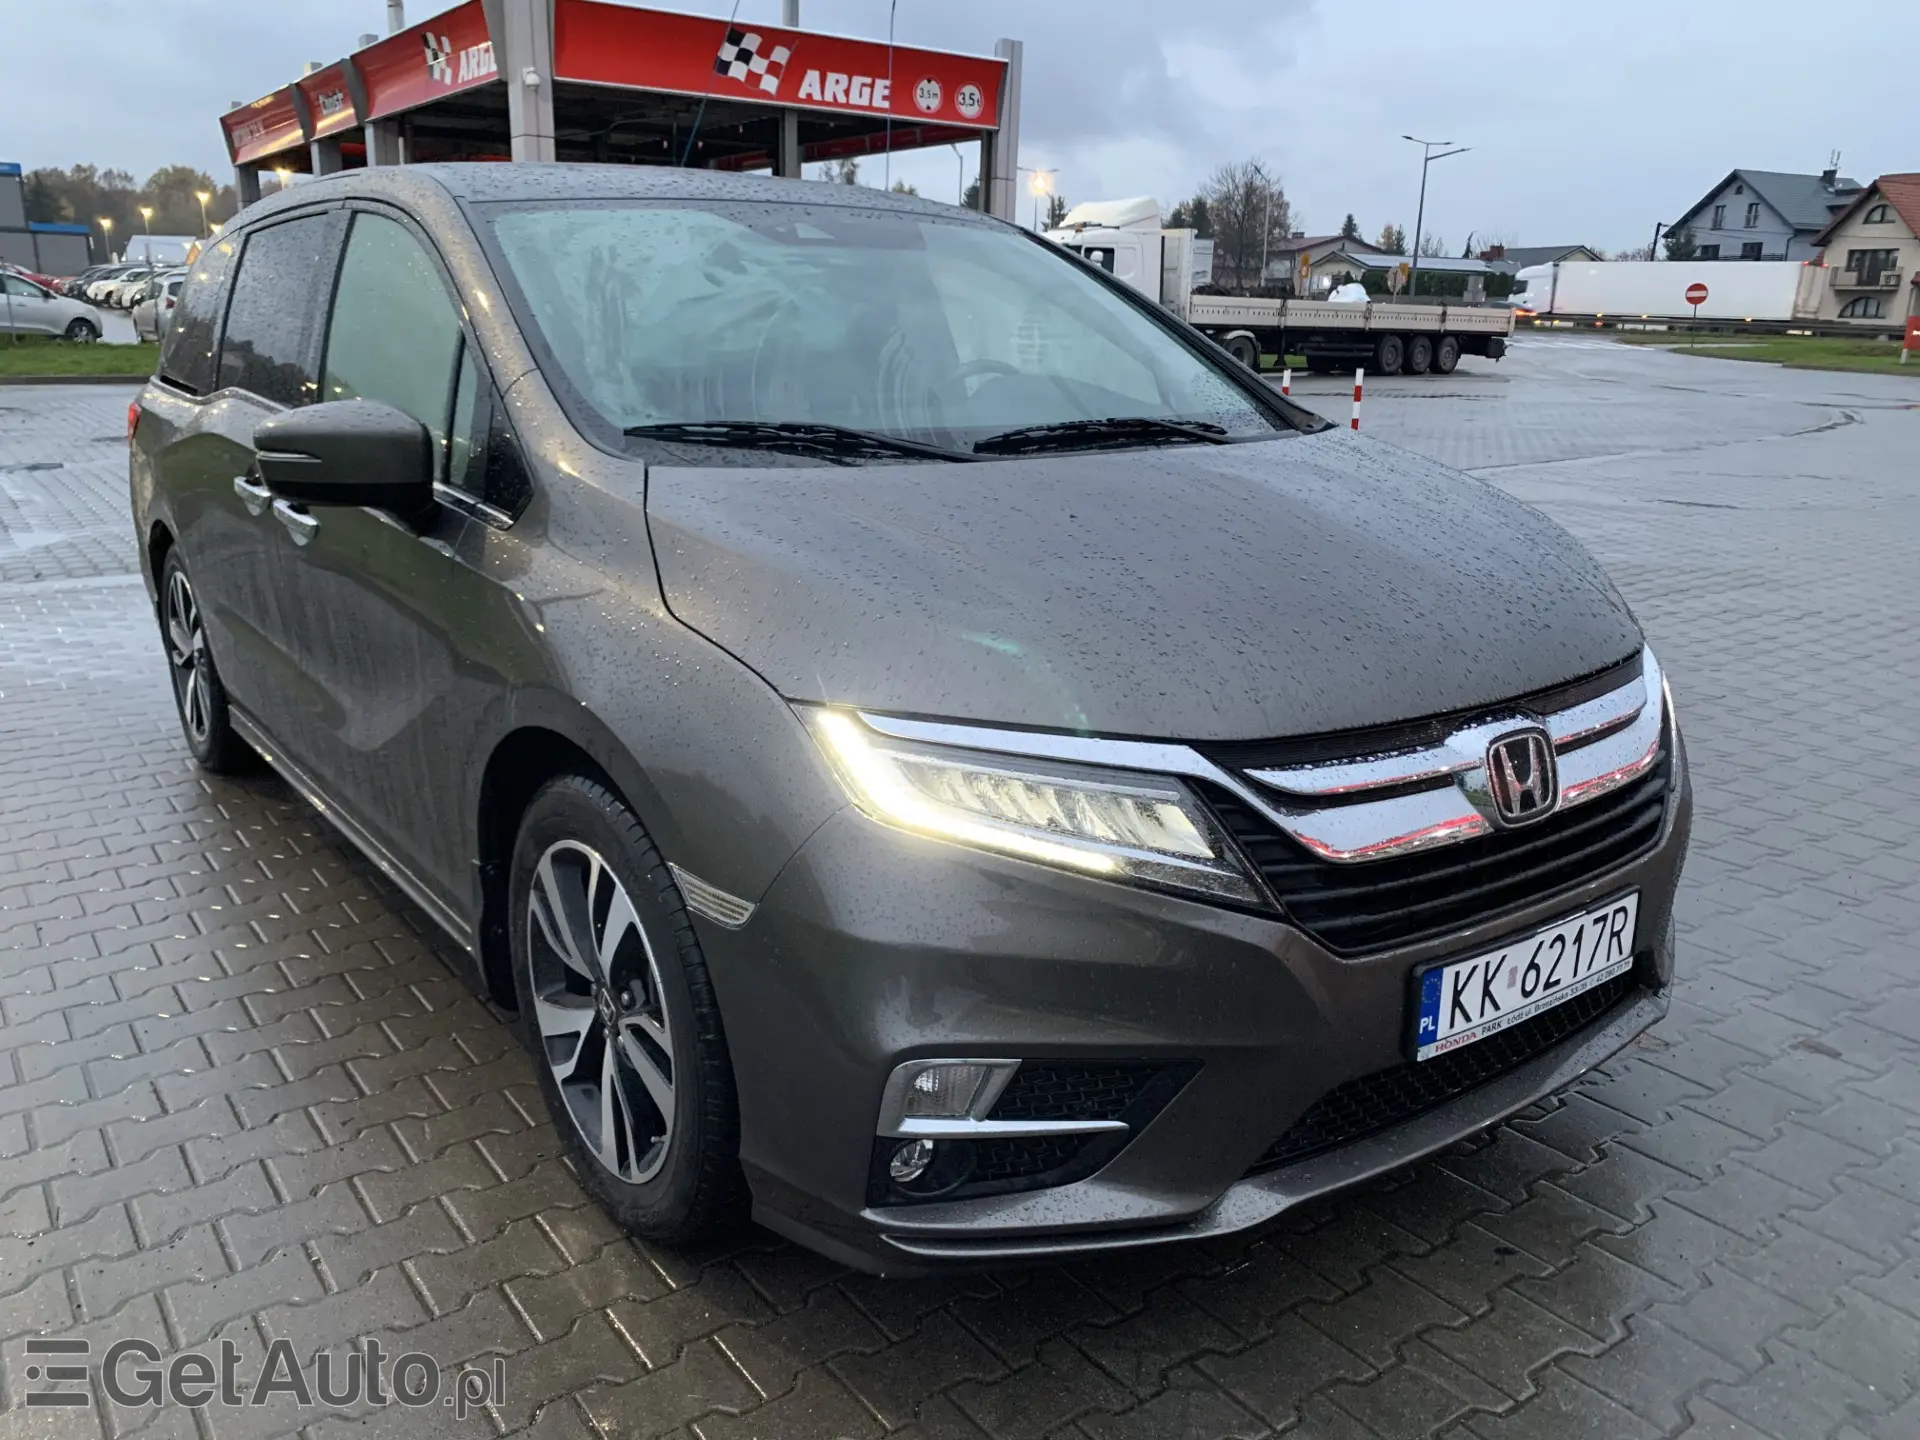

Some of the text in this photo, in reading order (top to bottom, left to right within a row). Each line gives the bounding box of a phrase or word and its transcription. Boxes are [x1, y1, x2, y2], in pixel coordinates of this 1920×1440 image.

[798, 70, 891, 109] ARGE
[1449, 906, 1628, 1030] KK 6217R
[1419, 1016, 1435, 1034] PL
[1435, 1032, 1477, 1052] HONDA
[1481, 1020, 1502, 1035] PARK
